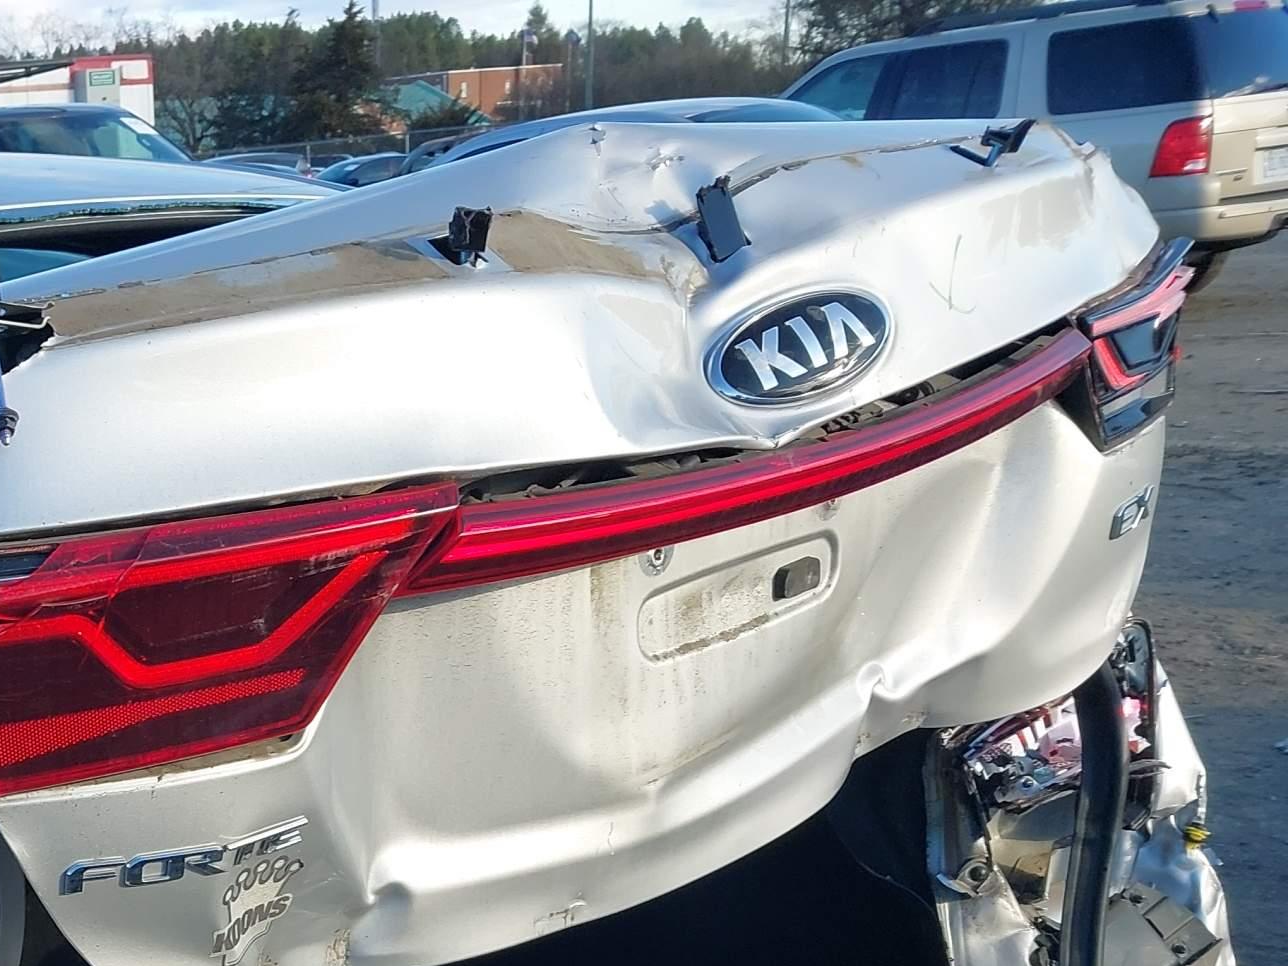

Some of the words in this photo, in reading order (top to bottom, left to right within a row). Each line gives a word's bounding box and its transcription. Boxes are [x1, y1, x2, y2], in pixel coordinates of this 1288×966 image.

[734, 301, 877, 391] KIA
[1108, 484, 1156, 541] EX
[59, 814, 310, 896] FORTE
[211, 894, 291, 954] KOONS
